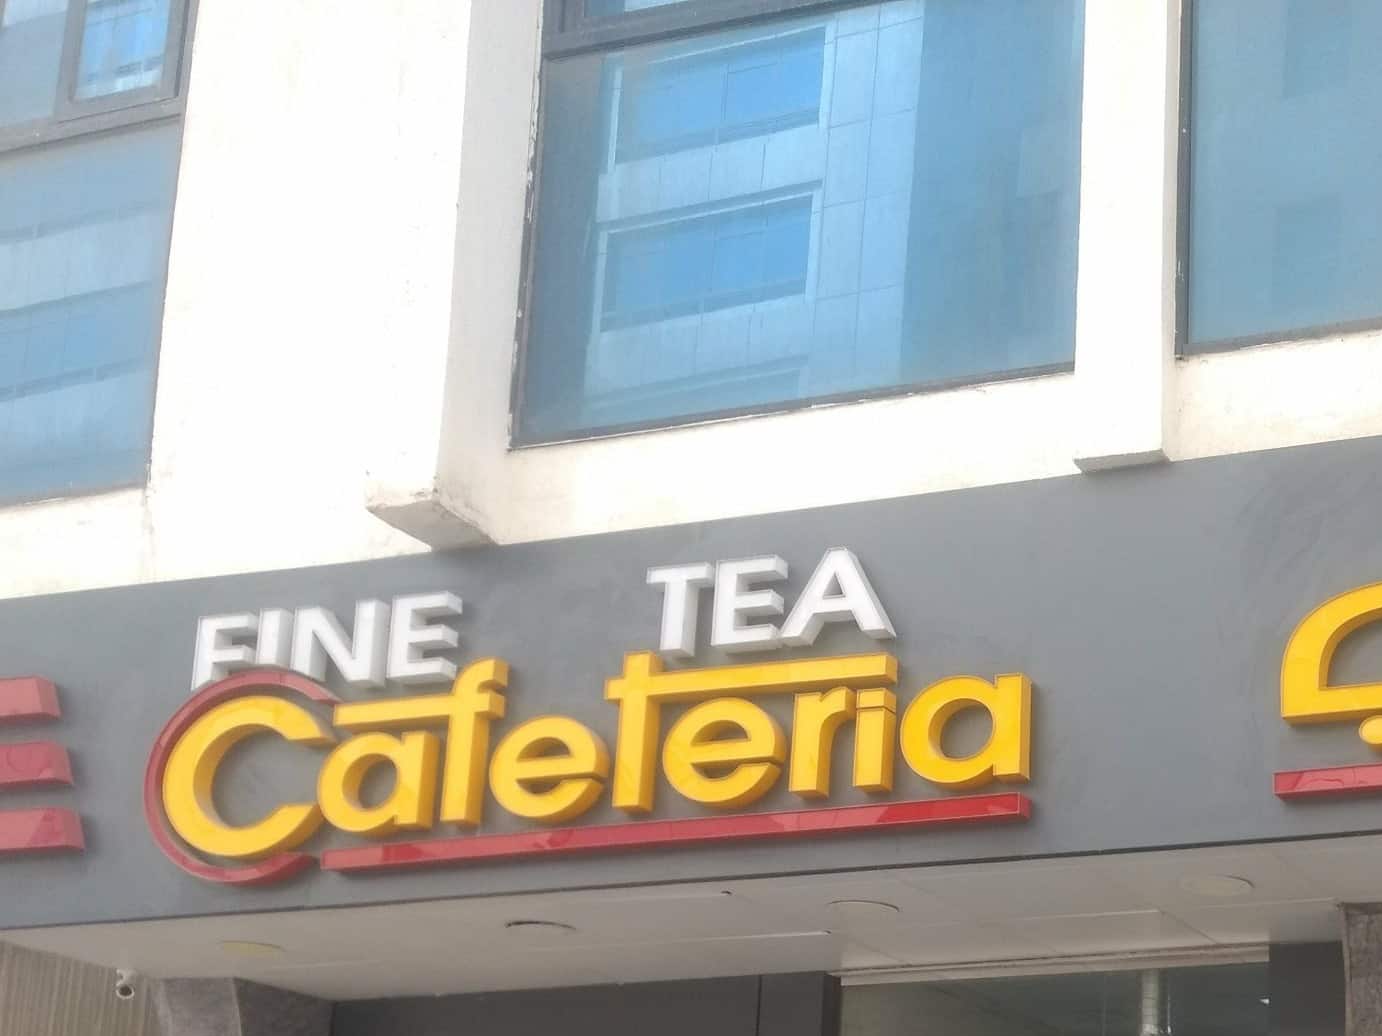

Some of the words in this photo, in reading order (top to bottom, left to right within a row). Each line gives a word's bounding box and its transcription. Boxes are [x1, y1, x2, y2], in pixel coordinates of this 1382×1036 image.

[190, 590, 465, 692] FINE
[645, 546, 898, 660] TEA
[162, 650, 1032, 860] Cafeteria
